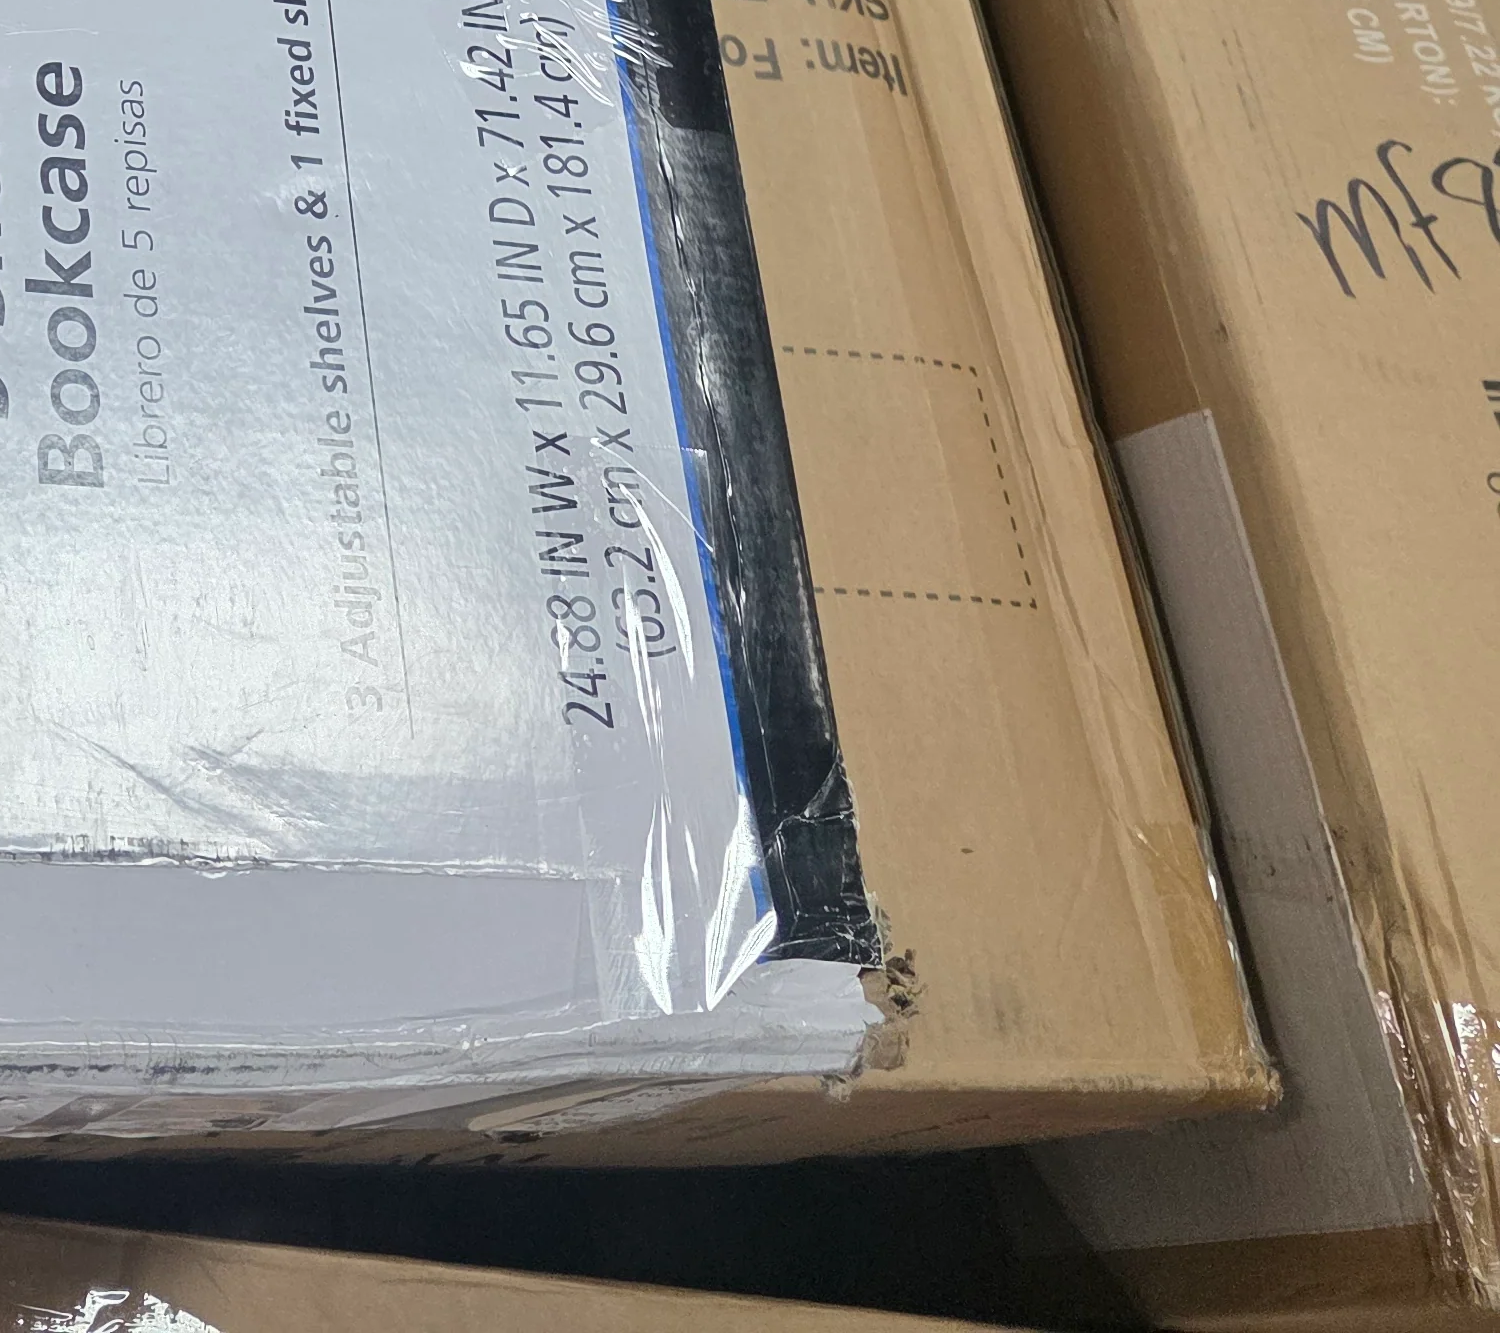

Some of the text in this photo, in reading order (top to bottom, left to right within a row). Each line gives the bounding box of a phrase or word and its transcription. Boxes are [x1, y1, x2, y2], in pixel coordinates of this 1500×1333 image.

[1347, 7, 1395, 64] CM)
[277, 36, 321, 137] fixed
[466, 44, 525, 149] 71.42
[800, 37, 908, 97] Item:
[290, 154, 324, 171] 1
[492, 161, 530, 188] x
[533, 93, 593, 198] 181.4
[293, 188, 330, 220] &
[488, 196, 536, 227] D
[561, 213, 600, 240] x
[23, 60, 105, 490] Bookcase
[113, 78, 171, 486] Librero de 5 repisas
[492, 239, 545, 284] IN
[568, 250, 610, 310] cm
[303, 233, 349, 395] shelves
[500, 297, 563, 413] 11.65
[567, 321, 629, 417] 29.6
[532, 429, 571, 456] x
[596, 425, 634, 454] x
[525, 465, 579, 515] W
[603, 465, 644, 531] cm
[316, 408, 383, 669] Adjustable
[535, 530, 590, 579] IN
[546, 594, 615, 730] 24.88
[345, 685, 384, 714] 3
